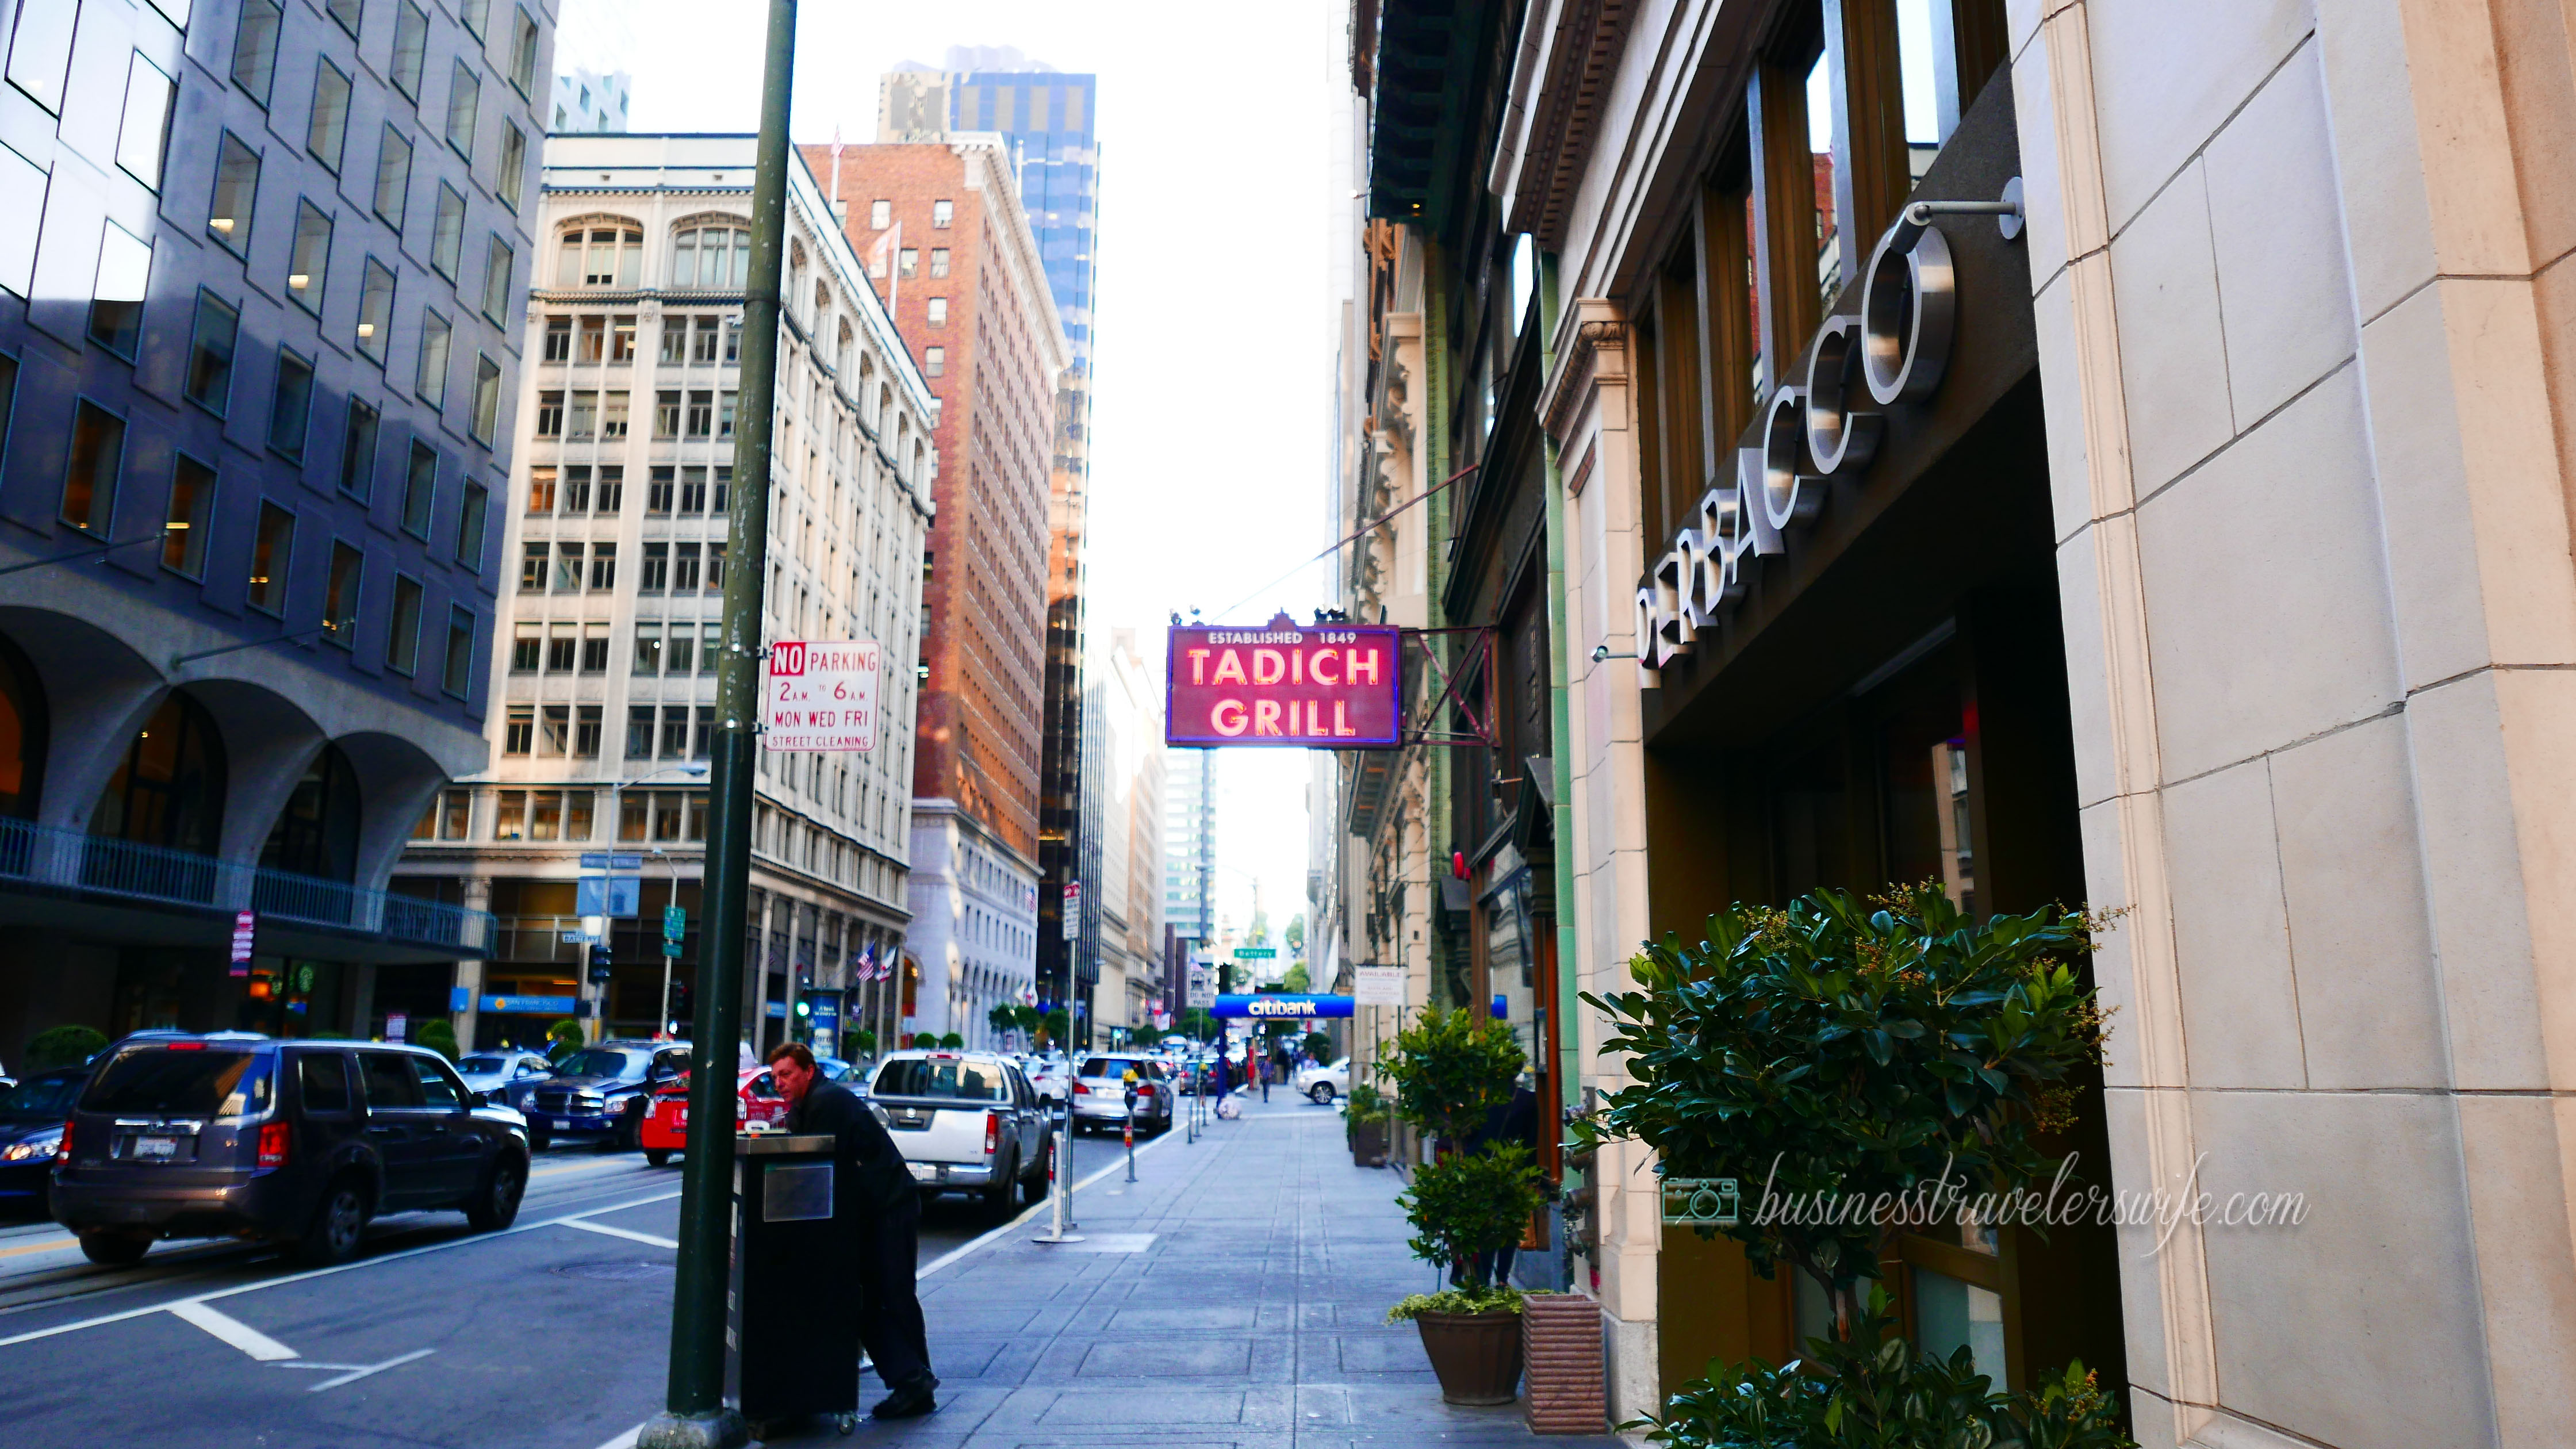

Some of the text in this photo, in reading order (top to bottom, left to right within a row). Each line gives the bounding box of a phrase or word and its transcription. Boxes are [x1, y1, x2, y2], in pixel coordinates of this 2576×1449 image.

[1635, 224, 1952, 687] PERBACCO
[1208, 632, 1357, 645] ESTABLISHED 1849
[774, 644, 876, 674] NO PARKING
[1187, 647, 1379, 685] TADICH
[779, 681, 791, 702] 2
[819, 684, 826, 692] TO
[833, 680, 847, 702] 6
[775, 710, 868, 728] MON WED FRI
[1210, 699, 1356, 737] GRILL
[772, 735, 869, 747] STREET CLEANING
[1239, 949, 1272, 959] Battery
[1247, 998, 1317, 1016] citibank
